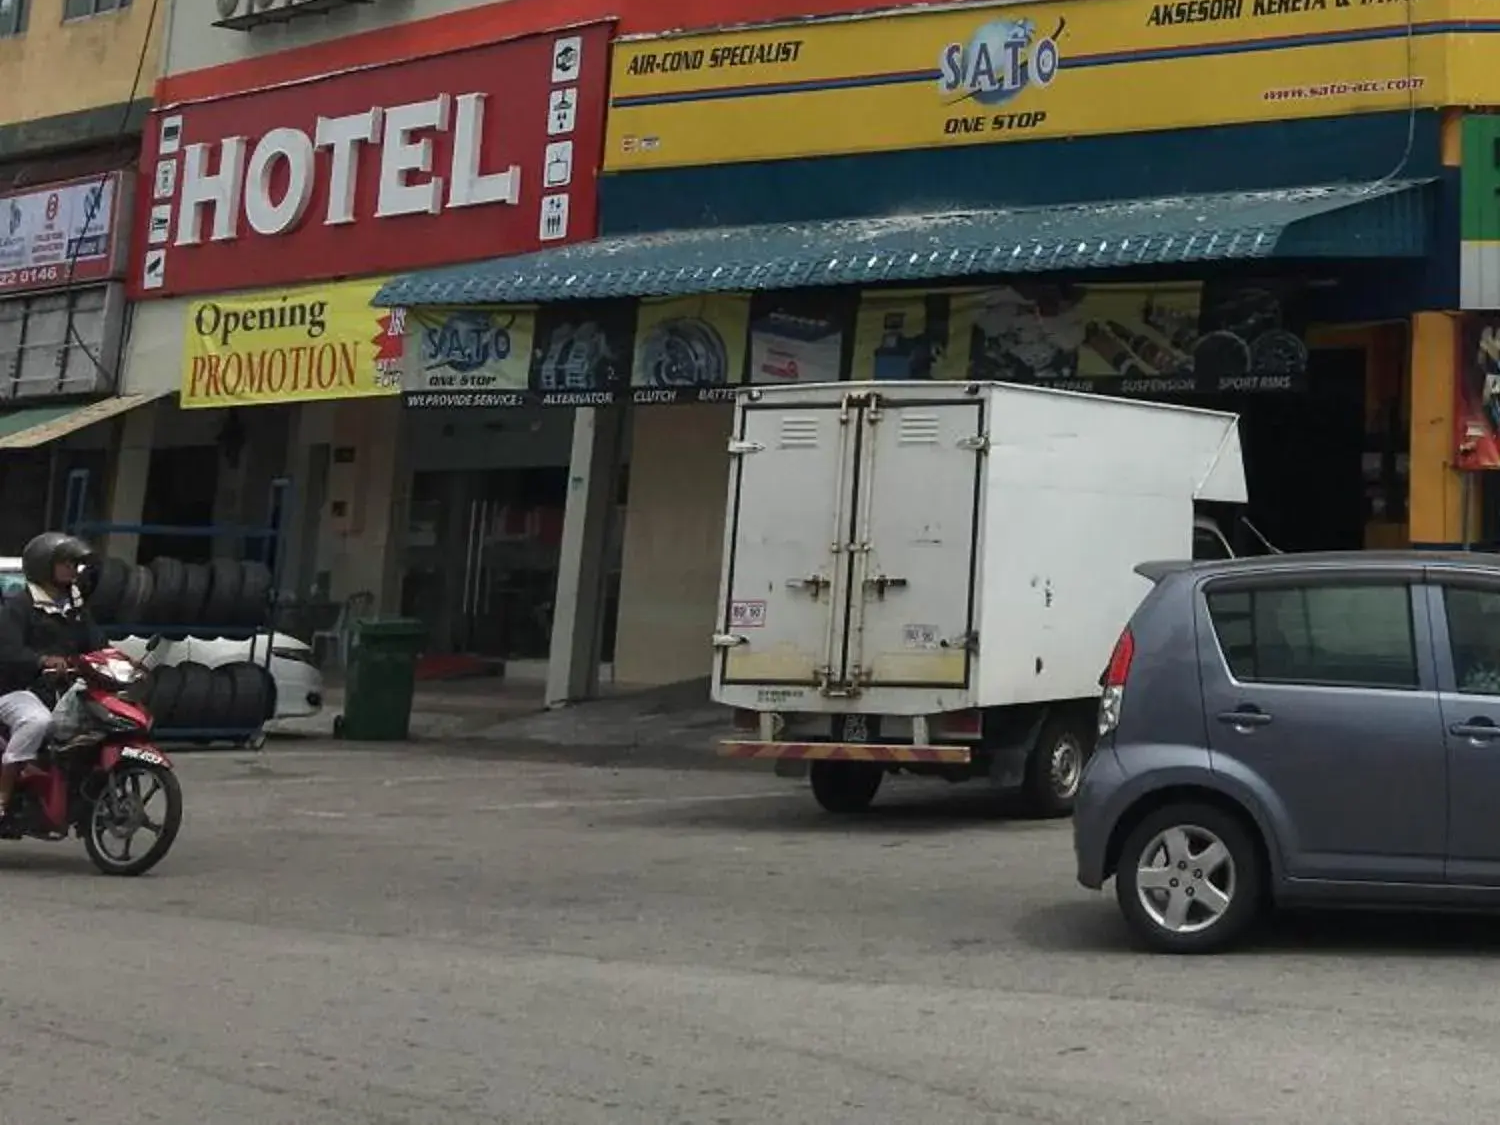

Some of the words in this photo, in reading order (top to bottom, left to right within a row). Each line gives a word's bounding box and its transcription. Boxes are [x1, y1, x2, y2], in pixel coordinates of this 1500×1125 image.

[626, 48, 703, 76] AIR-COND
[708, 40, 803, 69] SPECIALIST
[938, 36, 1058, 92] SATO
[944, 114, 985, 135] ONE
[990, 111, 1047, 131] STOP
[174, 92, 521, 247] HOTEL
[195, 296, 327, 337] Opening
[188, 340, 360, 398] PROMOTION
[633, 389, 677, 403] CLUTCH
[699, 388, 738, 401] BATTE
